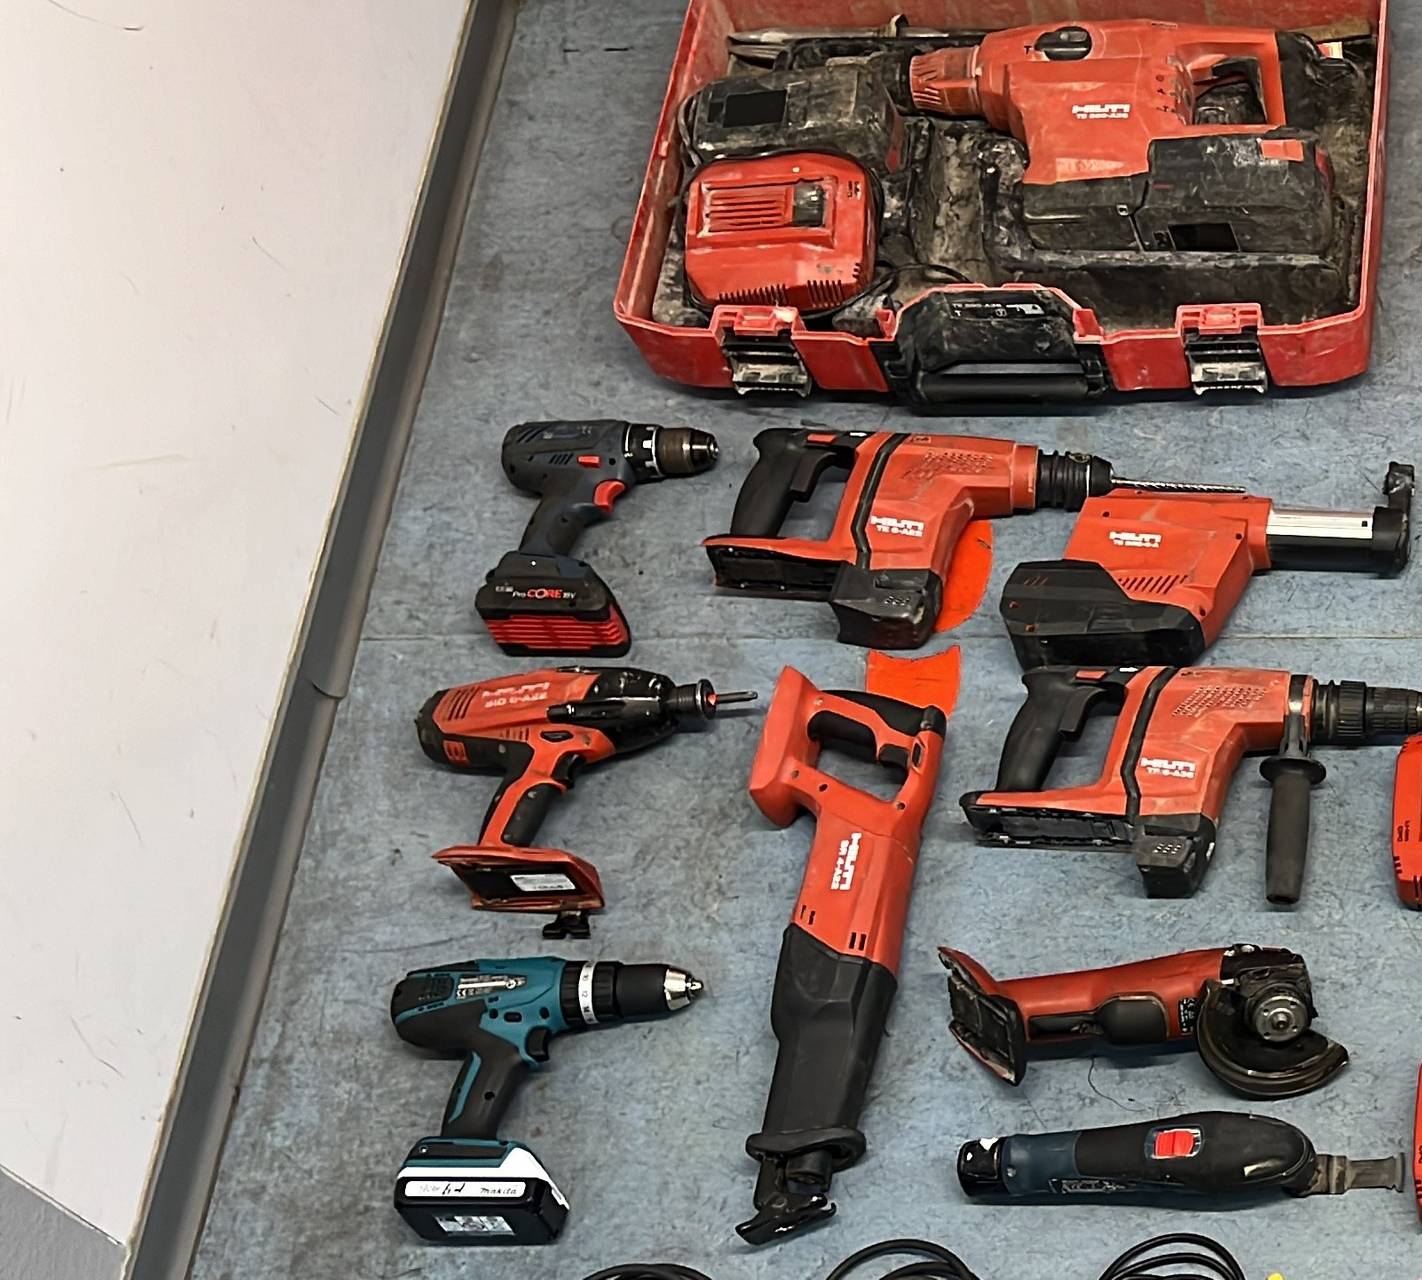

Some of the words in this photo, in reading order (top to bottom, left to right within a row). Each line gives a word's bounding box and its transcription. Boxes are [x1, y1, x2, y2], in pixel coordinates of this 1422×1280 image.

[1072, 104, 1130, 113] HILTI
[871, 515, 924, 530] HILTI
[877, 525, 889, 533] TE
[1109, 531, 1162, 543] HILTI
[1141, 757, 1196, 772] HILTI
[839, 840, 849, 856] SR
[840, 832, 862, 890] HILTI
